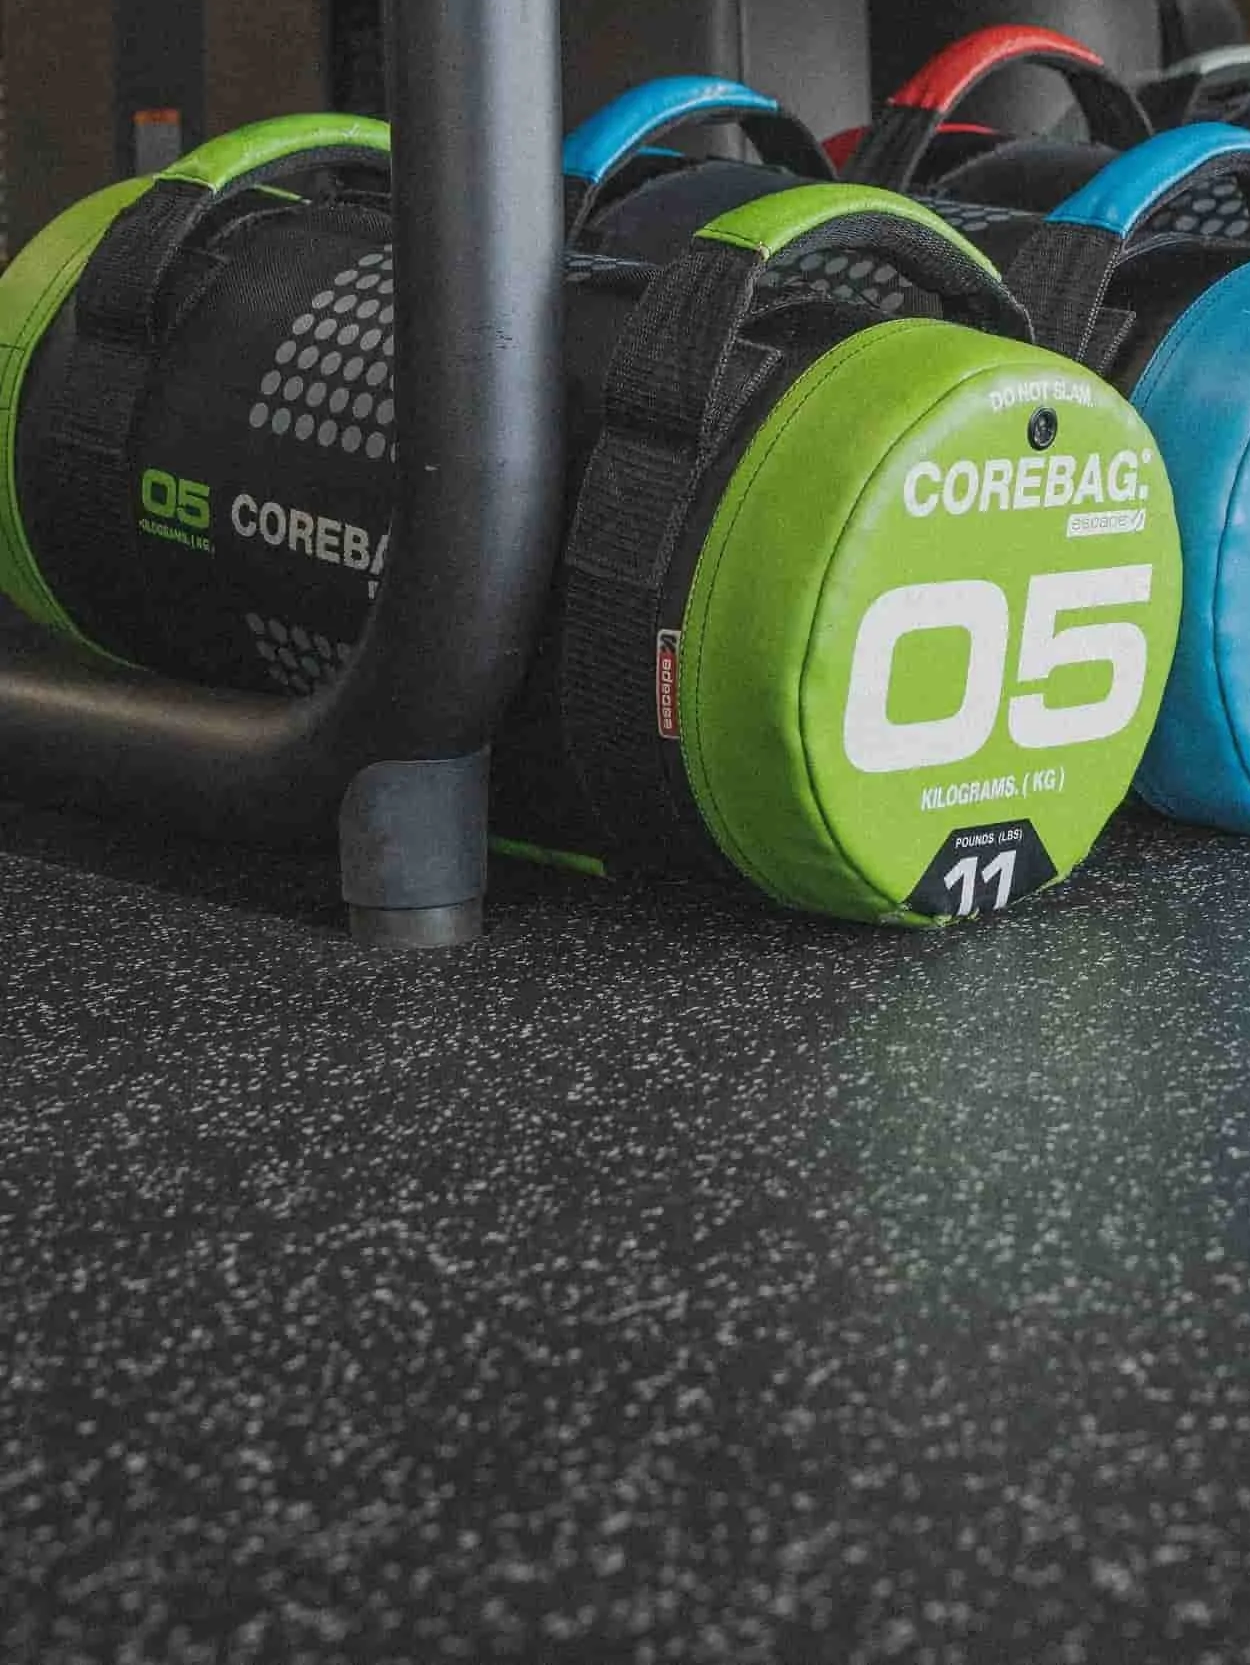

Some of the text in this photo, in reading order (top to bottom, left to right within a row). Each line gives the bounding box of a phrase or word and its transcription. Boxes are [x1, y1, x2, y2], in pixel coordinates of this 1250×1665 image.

[989, 390, 1015, 413] DO
[1018, 381, 1048, 403] NOT
[141, 468, 211, 530] 05
[661, 658, 674, 730] escape
[843, 564, 1153, 774] 05
[920, 775, 1019, 812] KILOGRAMS.
[954, 828, 1023, 849] POUNDS (LBS)
[943, 850, 1018, 917] 11
